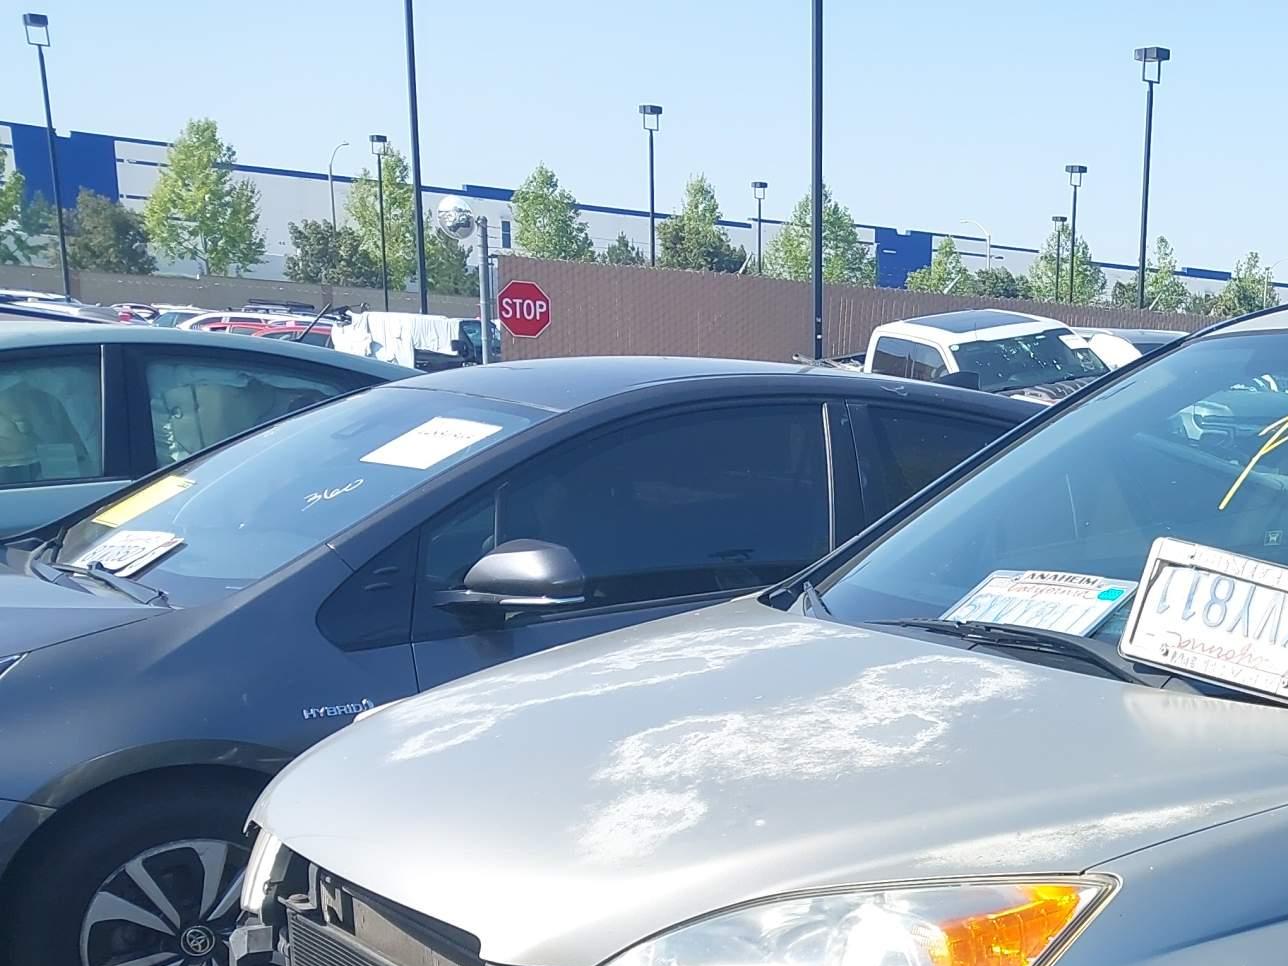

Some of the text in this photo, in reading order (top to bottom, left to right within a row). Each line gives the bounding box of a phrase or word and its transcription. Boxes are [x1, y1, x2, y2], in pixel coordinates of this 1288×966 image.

[501, 298, 547, 321] STOP
[1024, 572, 1098, 587] ANAHEIM
[302, 703, 362, 719] HYBRID
